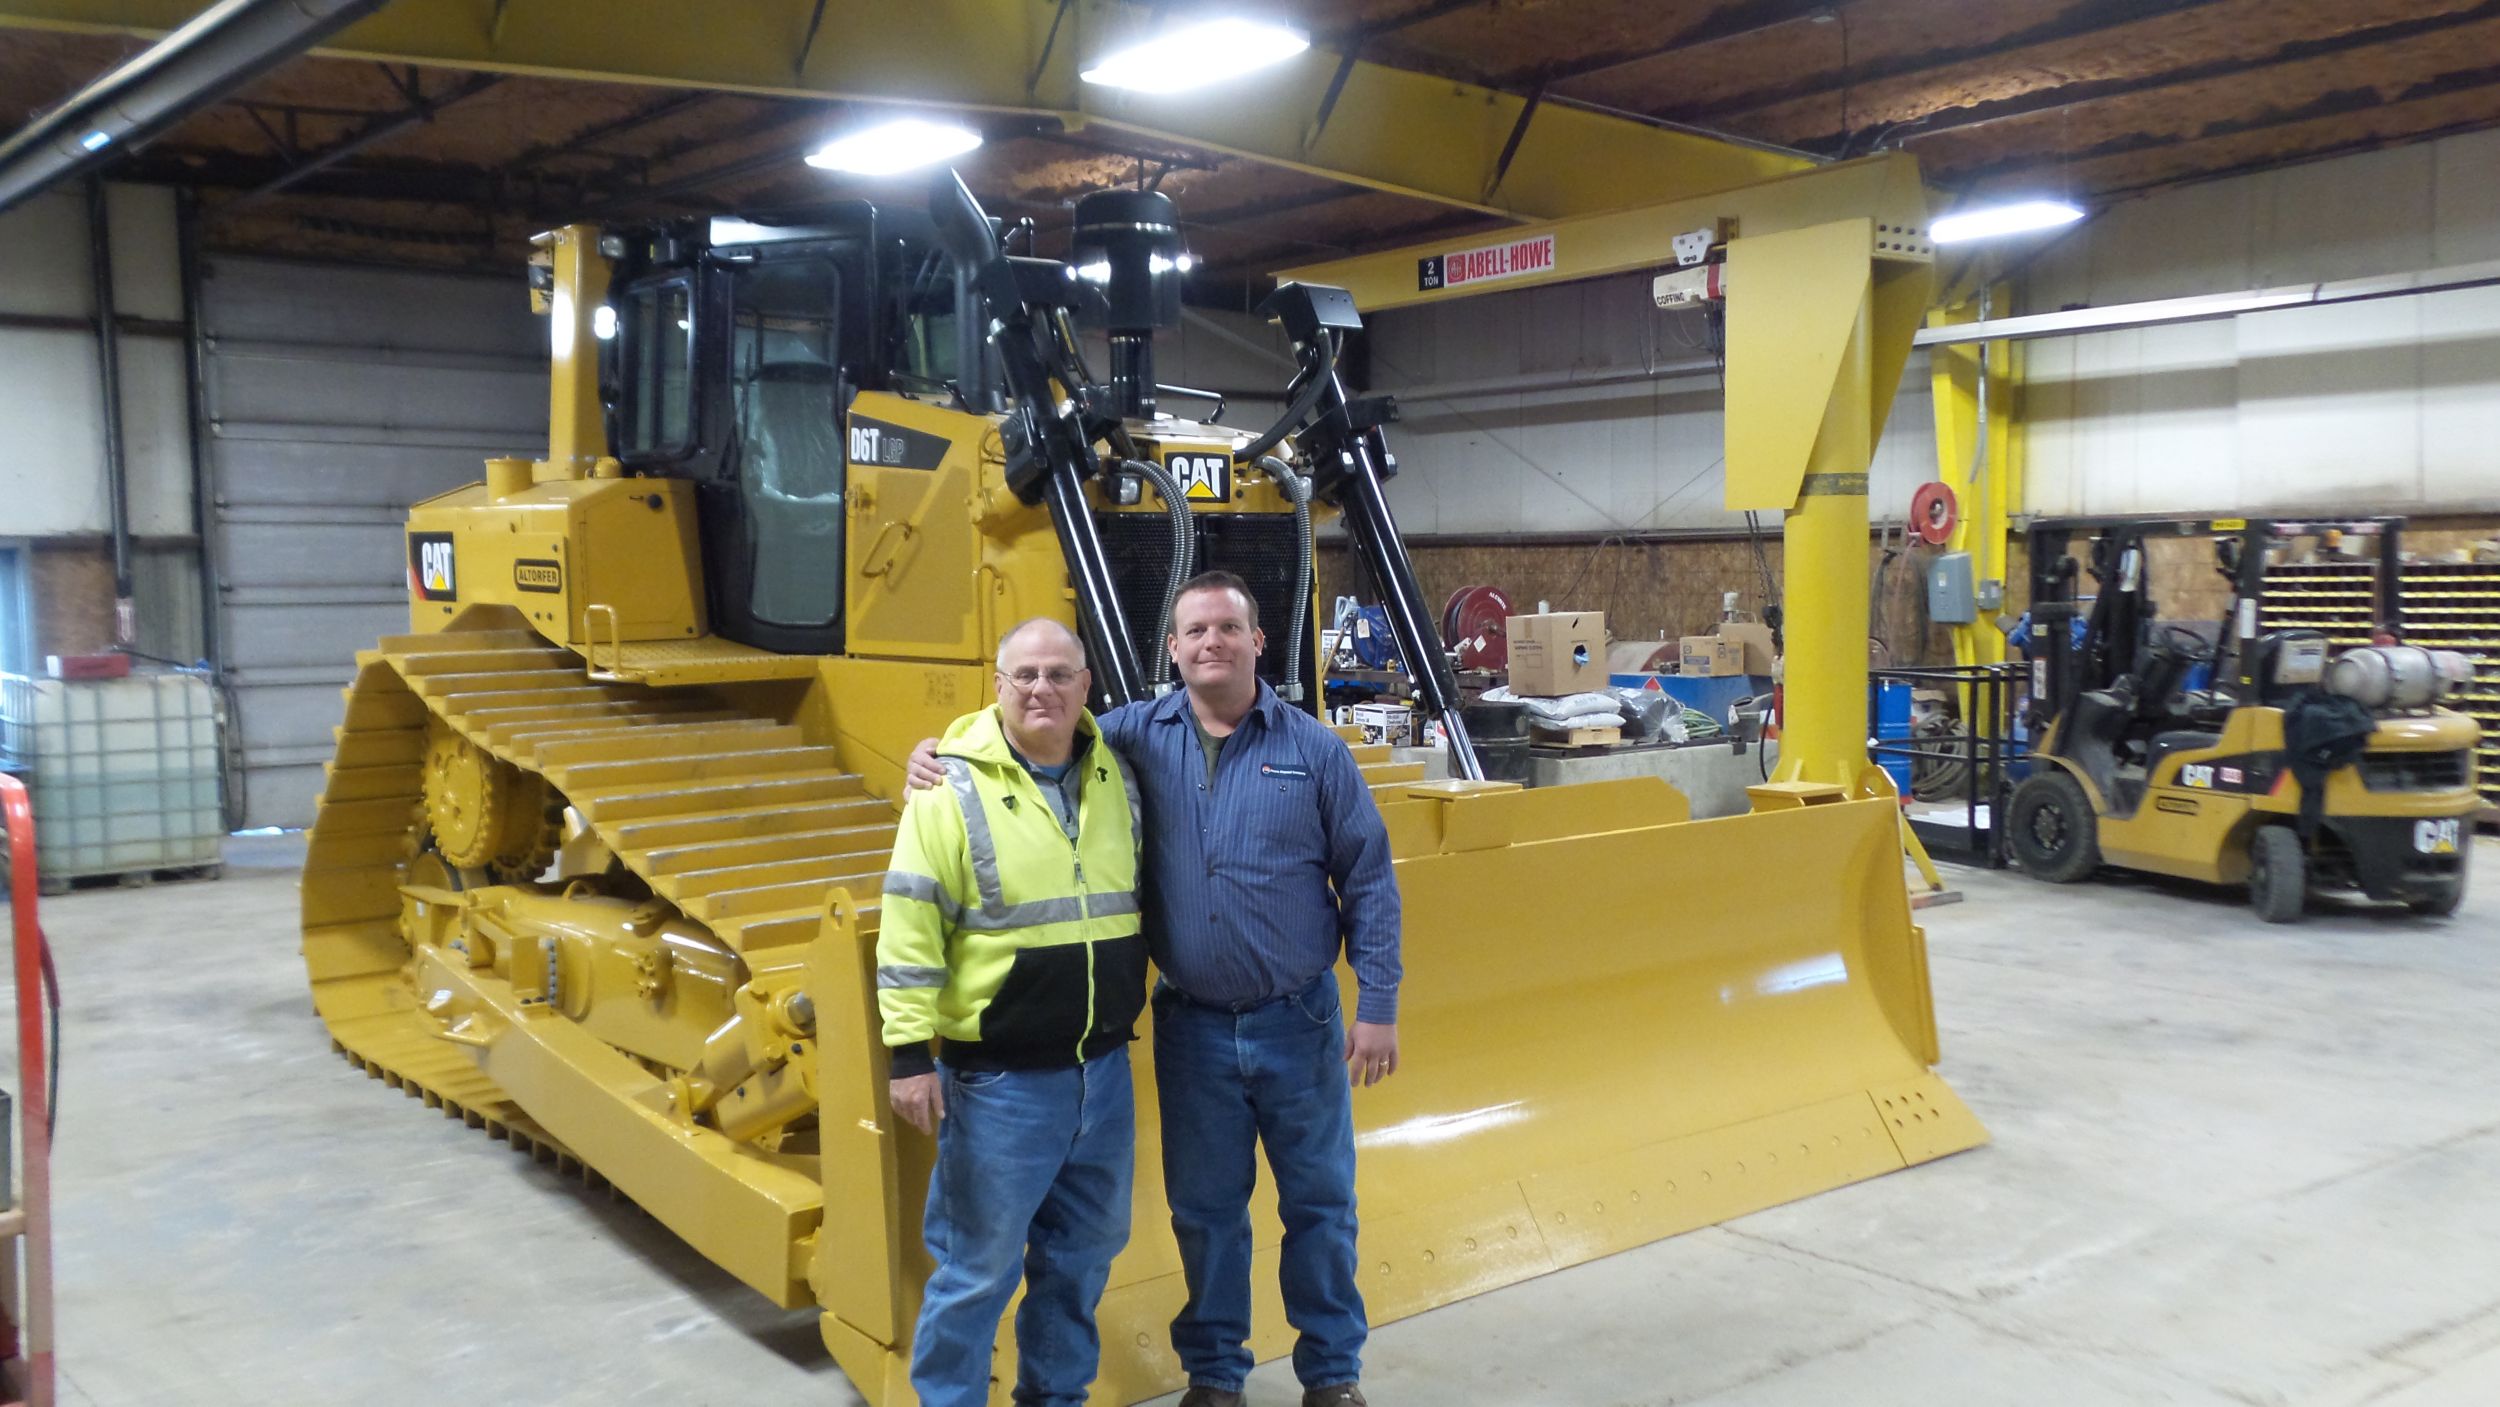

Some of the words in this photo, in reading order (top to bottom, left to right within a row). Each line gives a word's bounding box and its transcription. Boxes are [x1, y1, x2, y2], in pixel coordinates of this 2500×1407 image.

[1427, 260, 1435, 275] 2
[1467, 239, 1552, 280] ABELL-HOWE
[1424, 276, 1439, 287] TON
[1656, 291, 1685, 305] COFFING
[851, 427, 880, 462] D6T
[1171, 456, 1224, 498] CAT
[422, 541, 452, 590] CAT
[518, 568, 558, 584] ALTORFER
[2182, 764, 2215, 788] CAT
[2413, 819, 2459, 853] CAT
